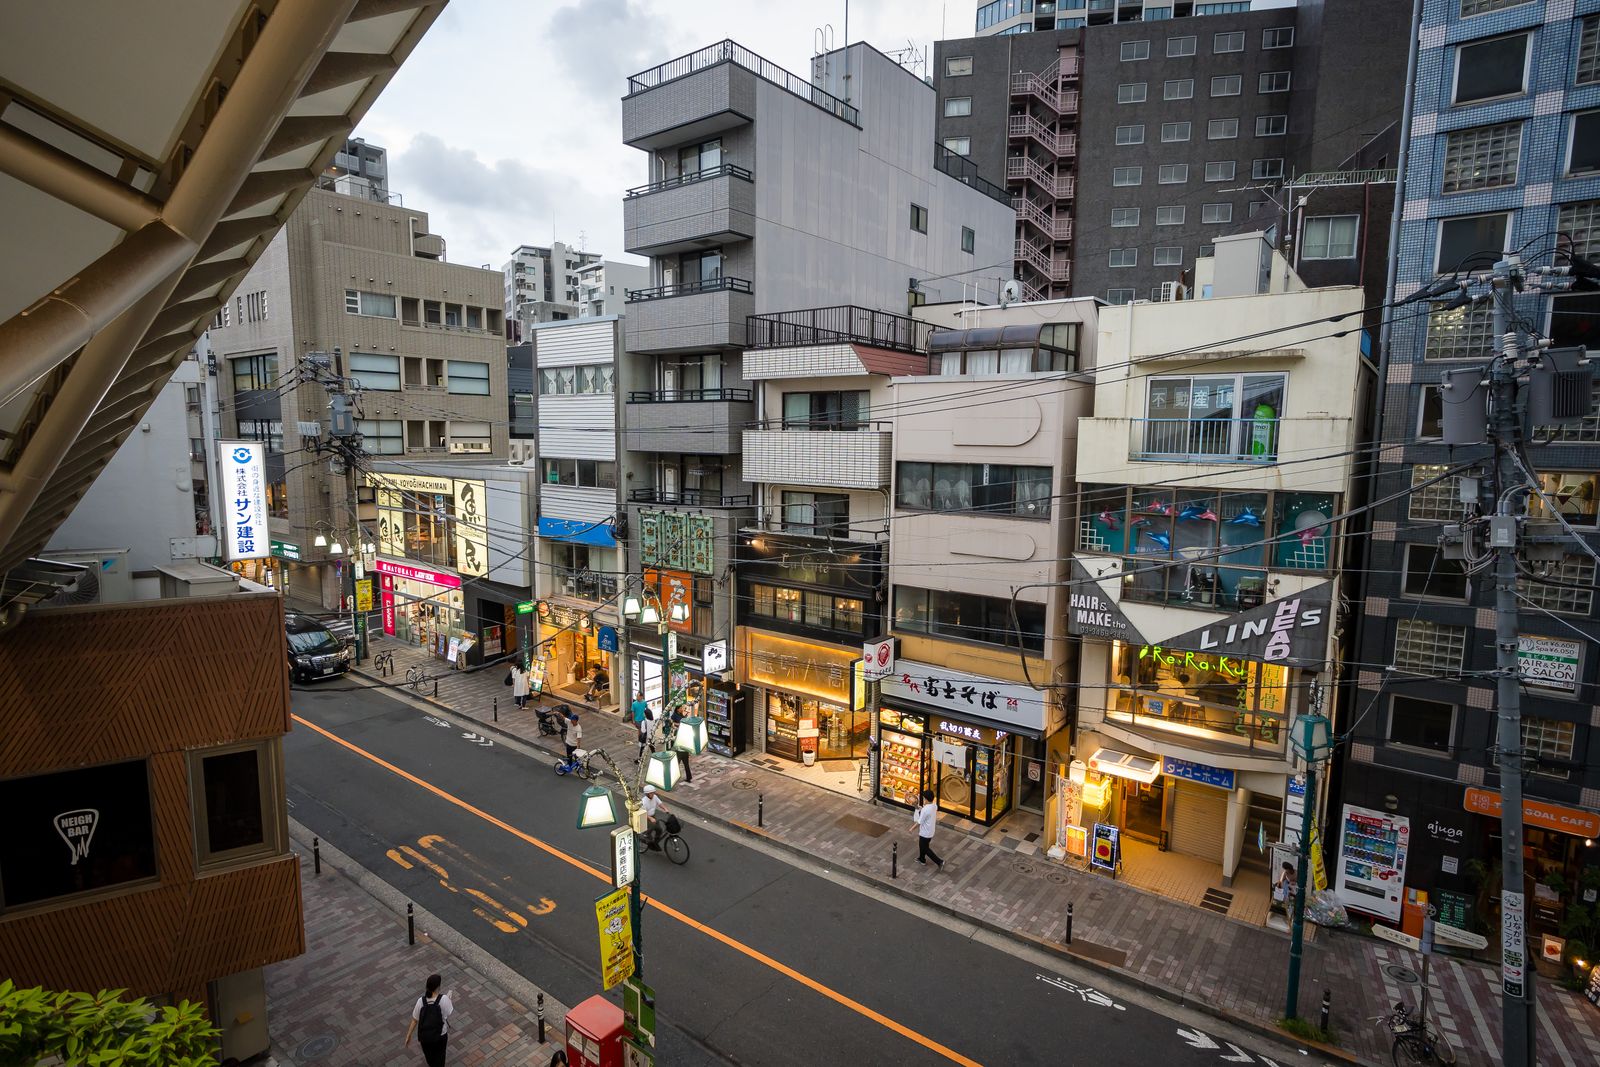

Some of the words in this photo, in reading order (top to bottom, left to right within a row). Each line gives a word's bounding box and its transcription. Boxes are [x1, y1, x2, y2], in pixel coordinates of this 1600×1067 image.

[1151, 389, 1208, 408] 不動産
[386, 565, 413, 577] NATURAL
[1071, 594, 1099, 610] HAIR
[1100, 602, 1107, 611] &
[1077, 610, 1112, 627] MAKE
[1112, 620, 1126, 629] the
[1532, 667, 1575, 680] SALON
[923, 676, 1000, 710] 富士そば
[1006, 697, 1019, 706] 24
[1166, 763, 1230, 787] タイユーホーム
[61, 814, 93, 828] NEIGH
[1524, 808, 1557, 821] GOAL
[1560, 816, 1594, 829] CAFE
[67, 825, 89, 838] BAR
[1427, 821, 1464, 838] ajuga
[1504, 912, 1513, 948] クリニック
[1513, 914, 1522, 946] いながき
